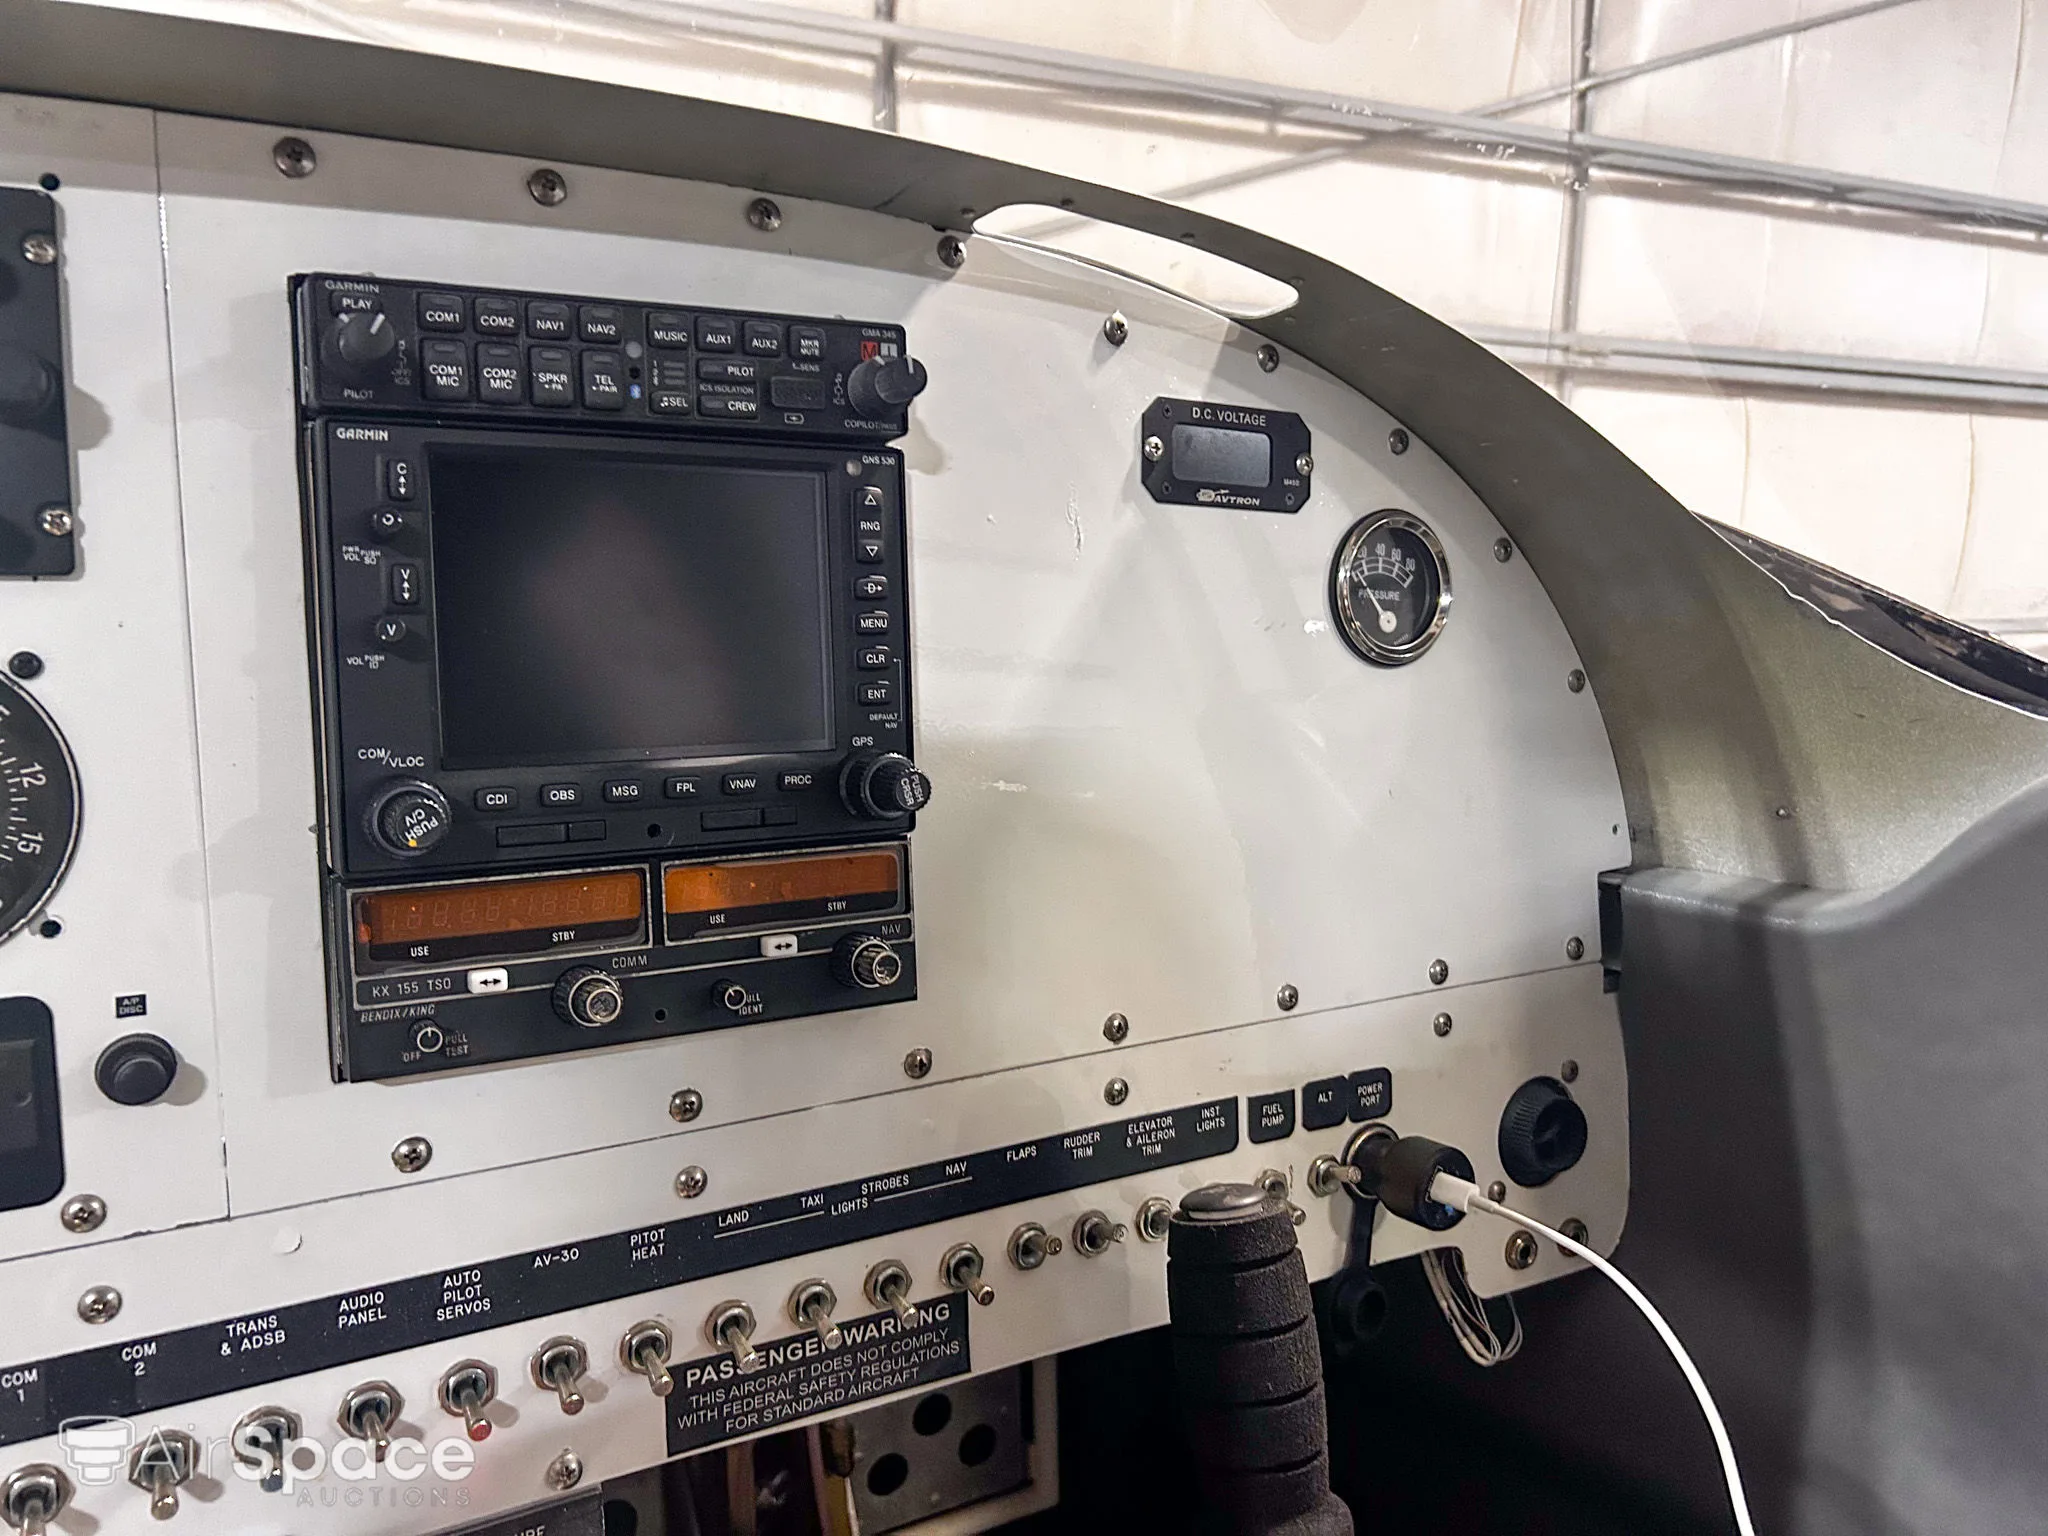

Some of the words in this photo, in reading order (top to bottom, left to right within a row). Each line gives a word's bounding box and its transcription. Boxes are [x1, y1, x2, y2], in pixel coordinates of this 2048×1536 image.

[325, 279, 380, 293] GARMIN
[342, 297, 372, 310] PLAY
[426, 311, 460, 324] COM1
[481, 315, 514, 328] COM2
[536, 319, 564, 331] NAV1
[587, 323, 616, 336] NAV2
[654, 330, 688, 343] MUSIC
[705, 333, 731, 345] AUX1
[862, 328, 881, 338] GMA
[751, 337, 777, 350] AUX2
[430, 363, 463, 377] COM1
[483, 367, 517, 380] COM2
[727, 365, 754, 377] PILOT
[436, 375, 459, 388] MIC
[490, 378, 513, 391] MIC
[538, 372, 568, 384] SPKR
[594, 374, 614, 386] TEL
[343, 388, 373, 399] PILOT
[715, 385, 754, 396] ISOLATION
[669, 396, 688, 408] SEL
[727, 400, 757, 413] CREW
[1192, 407, 1215, 421] D.C.
[1217, 409, 1266, 426] VOLTAGE
[336, 427, 389, 441] GARMIN
[396, 463, 407, 475] C
[860, 521, 881, 532] RNG
[342, 545, 360, 553] PWR
[360, 549, 381, 557] PUSH
[1375, 543, 1385, 556] 40
[1391, 547, 1401, 561] 60
[343, 552, 361, 561] VOL
[364, 556, 377, 565] SQ
[400, 568, 410, 580] V
[386, 623, 396, 636] V
[860, 618, 888, 629] MENU
[346, 656, 364, 666] VOL
[364, 654, 385, 662] PUSH
[866, 653, 886, 664] CLR
[867, 689, 887, 699] ENT
[869, 713, 898, 722] DEFAULT
[885, 722, 898, 730] NAV
[852, 736, 874, 747] GPS
[19, 762, 46, 788] 12
[784, 775, 812, 786] PROC
[676, 782, 696, 794] FPL
[729, 778, 757, 790] VNAV
[911, 774, 924, 802] PUSH
[549, 790, 575, 801] OBS
[612, 785, 639, 797] MSG
[901, 777, 914, 806] CRSR
[486, 794, 508, 805] CDI
[404, 816, 439, 841] PUSH
[17, 832, 44, 855] 15
[827, 900, 847, 912] STBY
[709, 914, 726, 925] USE
[881, 924, 902, 935] NAV
[552, 930, 576, 943] STBY
[410, 945, 430, 957] USE
[611, 955, 648, 969] COMM
[372, 984, 390, 998] KX
[397, 981, 419, 995] 155
[747, 992, 761, 1003] ULL
[119, 1005, 144, 1015] DISC
[360, 1003, 436, 1023] BENDIX/KING
[403, 1051, 421, 1062] OFF
[446, 1045, 469, 1057] TEST
[1357, 1081, 1383, 1097] POWER
[1317, 1091, 1333, 1103] ALT
[1360, 1093, 1381, 1107] PORT
[1201, 1105, 1220, 1119] INST
[1263, 1102, 1283, 1115] FUEL
[1128, 1115, 1173, 1135] ELEVATOR
[1196, 1117, 1226, 1133] LIGHTS
[1261, 1114, 1284, 1128] PUMP
[1063, 1131, 1100, 1149] RUDDER
[1126, 1137, 1133, 1148] &
[1135, 1127, 1176, 1145] AILERON
[1006, 1145, 1037, 1162] FLAPS
[1072, 1146, 1093, 1160] TRIM
[1142, 1142, 1162, 1156] TRIM
[945, 1161, 967, 1176] NAV
[861, 1174, 909, 1195] STROBES
[801, 1193, 824, 1209] TAXI
[831, 1196, 869, 1216] LIGHTS
[718, 1210, 749, 1227] LAND
[630, 1227, 666, 1247] PITOT
[533, 1247, 580, 1269] AV-30
[632, 1243, 665, 1261] HEAT
[443, 1269, 481, 1289] AUTO
[444, 1284, 483, 1304] PILOT
[339, 1291, 385, 1313] AUDIO
[436, 1299, 491, 1322] SERVOS
[339, 1307, 387, 1329] PANEL
[225, 1315, 278, 1338] TRANS
[220, 1342, 232, 1356] &
[241, 1330, 286, 1353] ADSB
[686, 1337, 826, 1389] PASENGE
[843, 1303, 950, 1347] WARNG
[121, 1341, 157, 1361] COM
[134, 1363, 145, 1377] 2
[689, 1388, 725, 1409] THIS
[729, 1369, 806, 1399] AIRCRAFT
[810, 1355, 853, 1377] DOES
[857, 1347, 888, 1365] NOT
[890, 1329, 949, 1354] COMPLY
[1, 1367, 39, 1388] COM
[677, 1408, 718, 1430] WITH
[724, 1390, 793, 1417] FEDERAL
[798, 1373, 855, 1397] SAFETY
[861, 1341, 960, 1378] REGULATIONS
[17, 1389, 25, 1403] 1
[726, 1417, 758, 1433] FOR
[763, 1389, 845, 1421] STANDARD
[848, 1367, 920, 1397] AIRCRAFT
